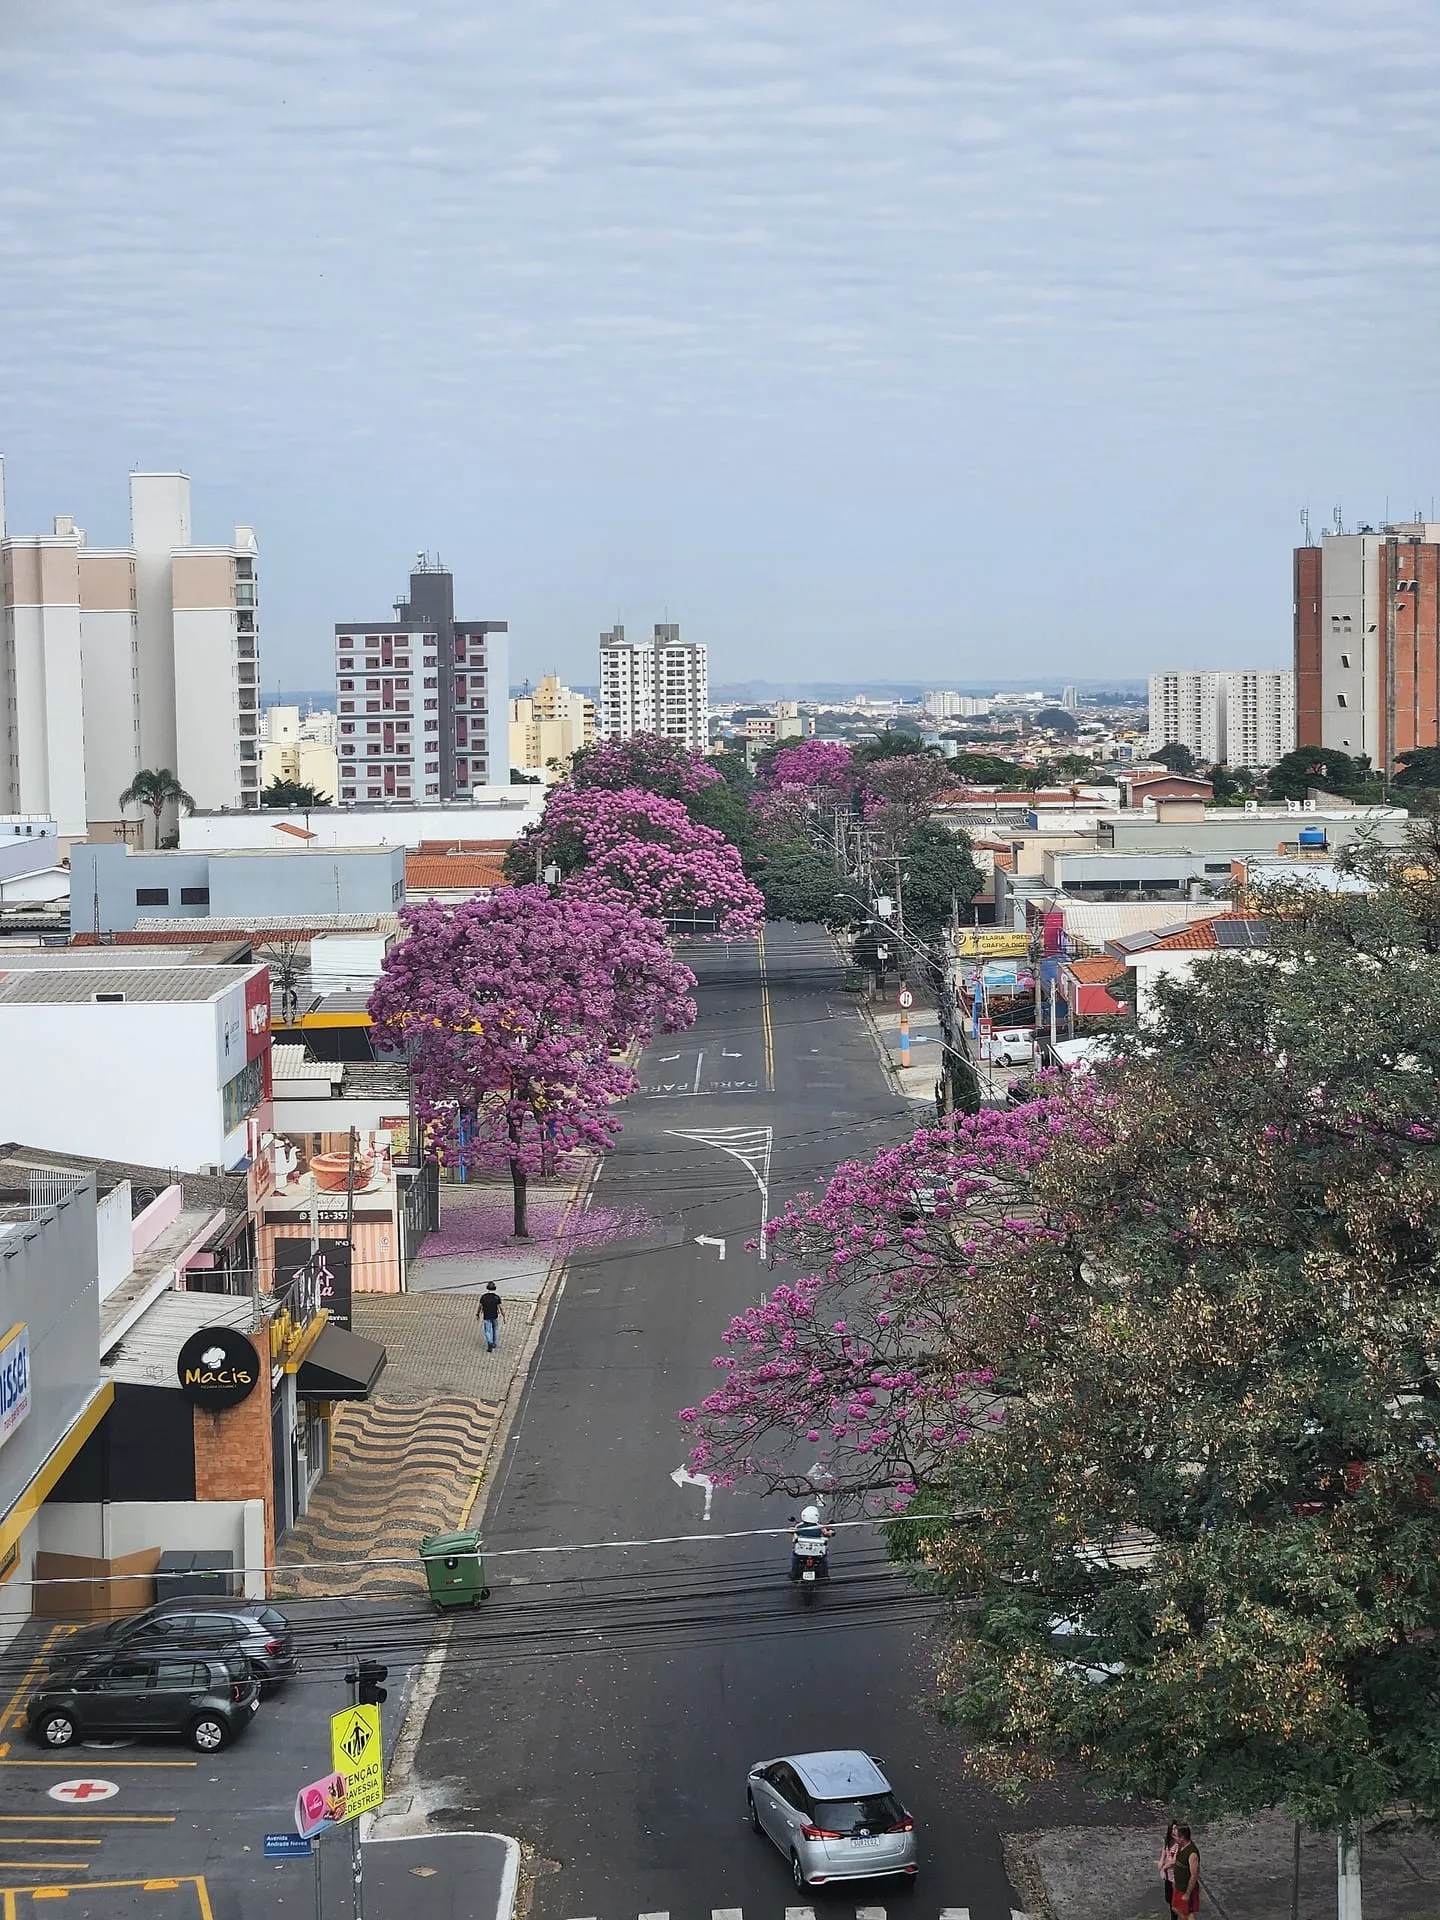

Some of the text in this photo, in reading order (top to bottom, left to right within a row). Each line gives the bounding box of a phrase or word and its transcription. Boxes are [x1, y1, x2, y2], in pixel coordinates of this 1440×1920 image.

[185, 1367, 252, 1385] Macis
[344, 1763, 379, 1788] TENÇÃO
[346, 1790, 380, 1815] DESTRES
